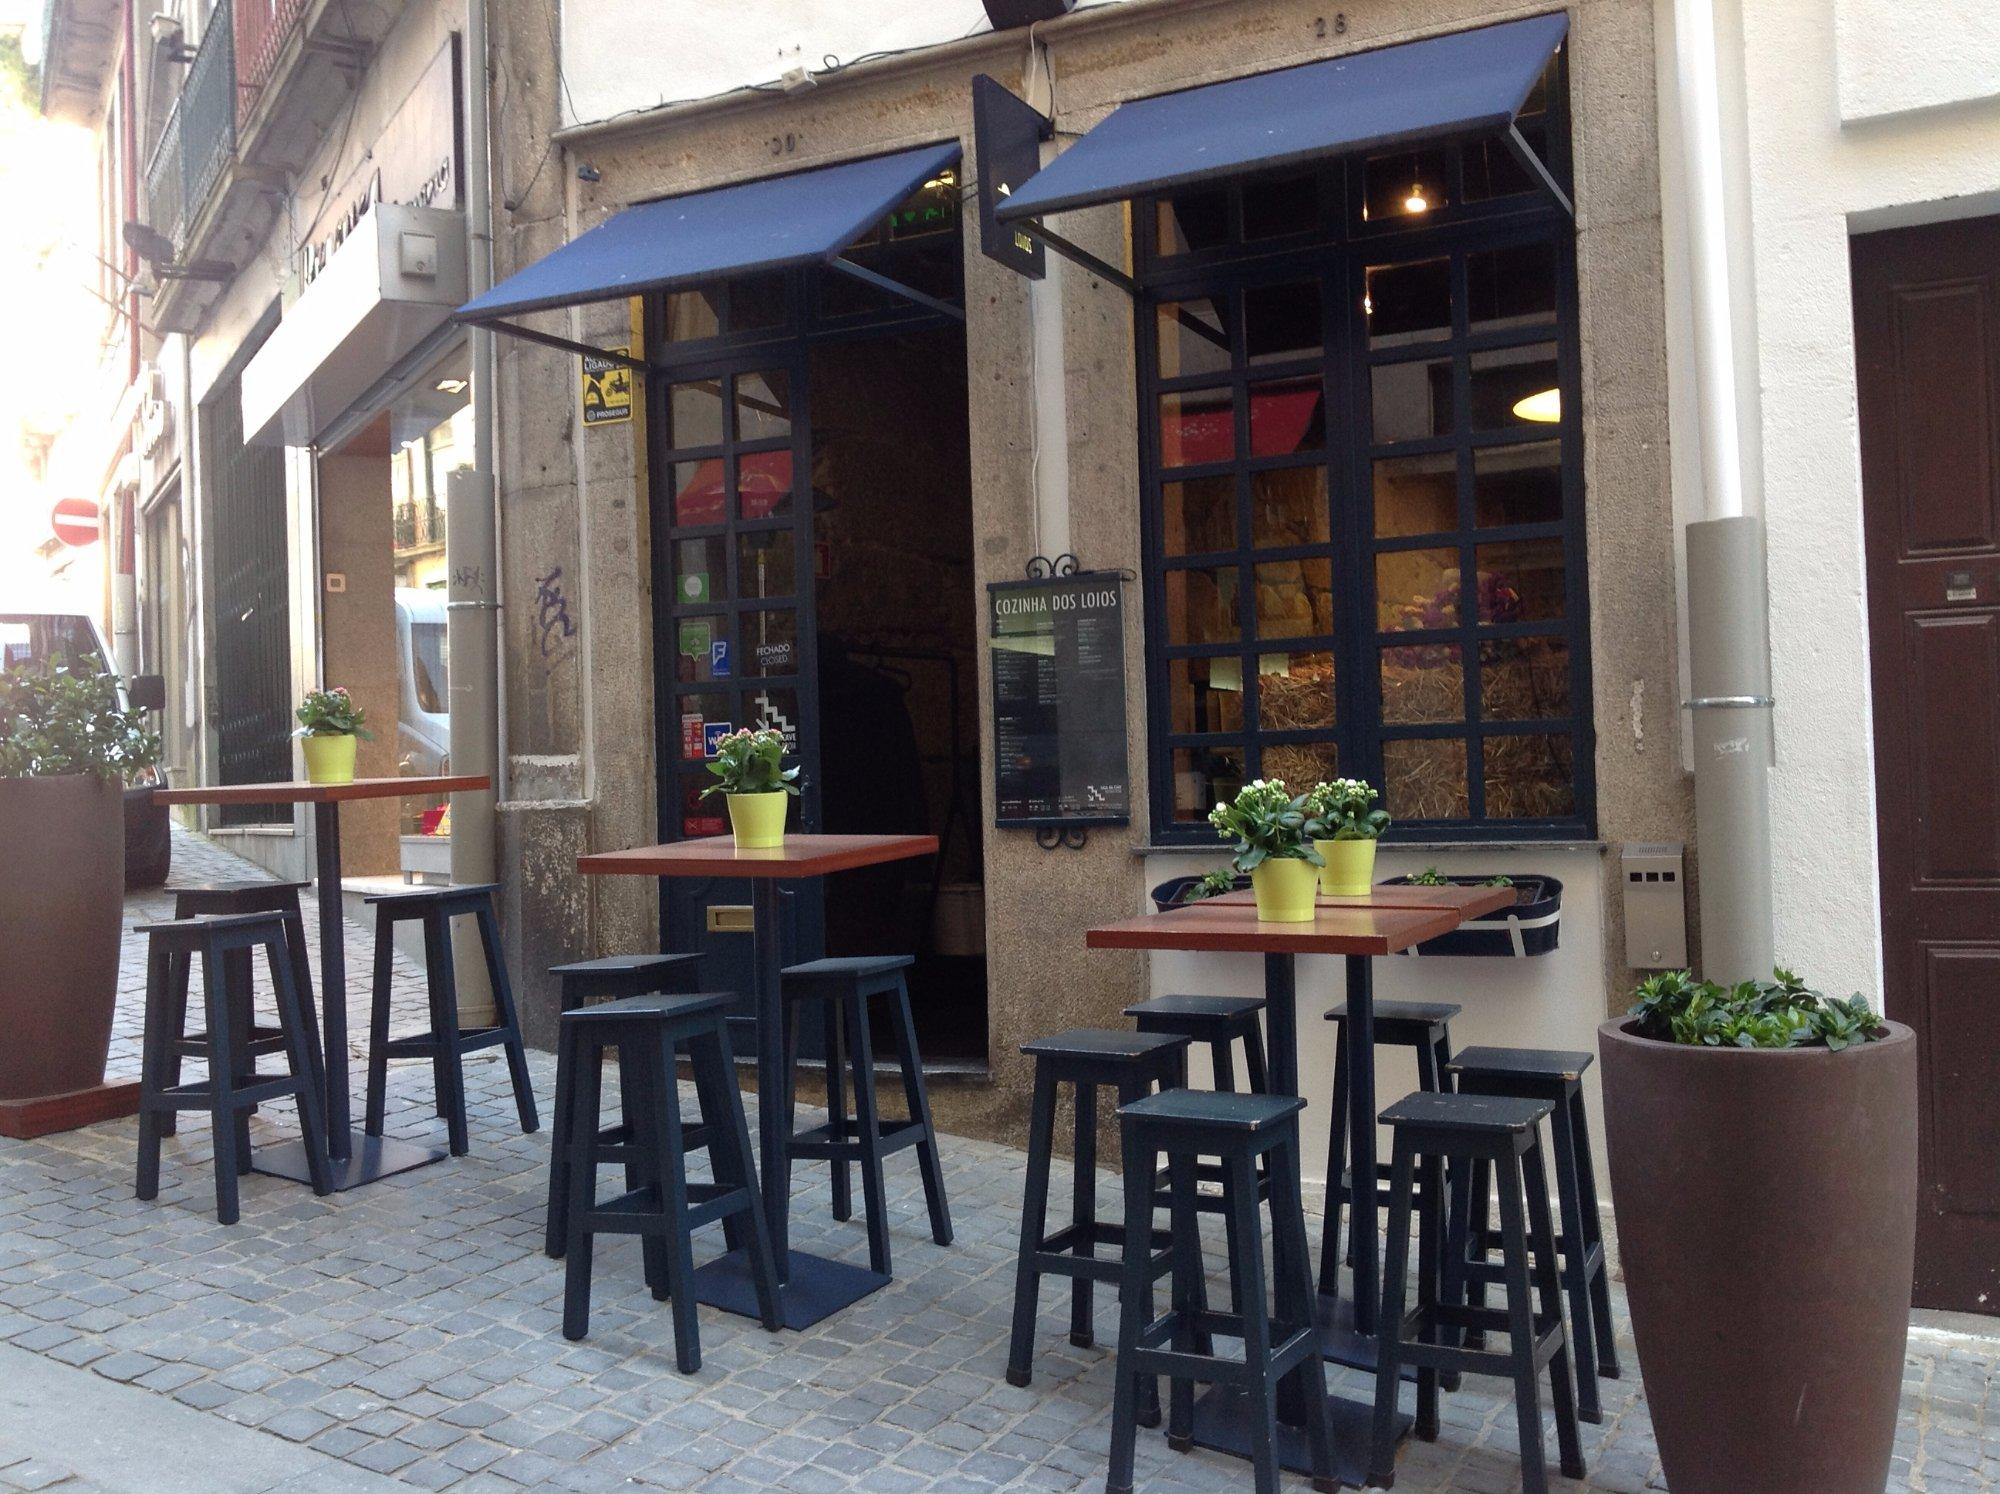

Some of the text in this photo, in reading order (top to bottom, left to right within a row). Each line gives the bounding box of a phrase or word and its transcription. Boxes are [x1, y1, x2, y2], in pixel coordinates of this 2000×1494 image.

[596, 407, 629, 418] PROSEGUR
[995, 590, 1117, 615] COZINHA DOS LOIOS
[756, 643, 791, 656] FECHADO
